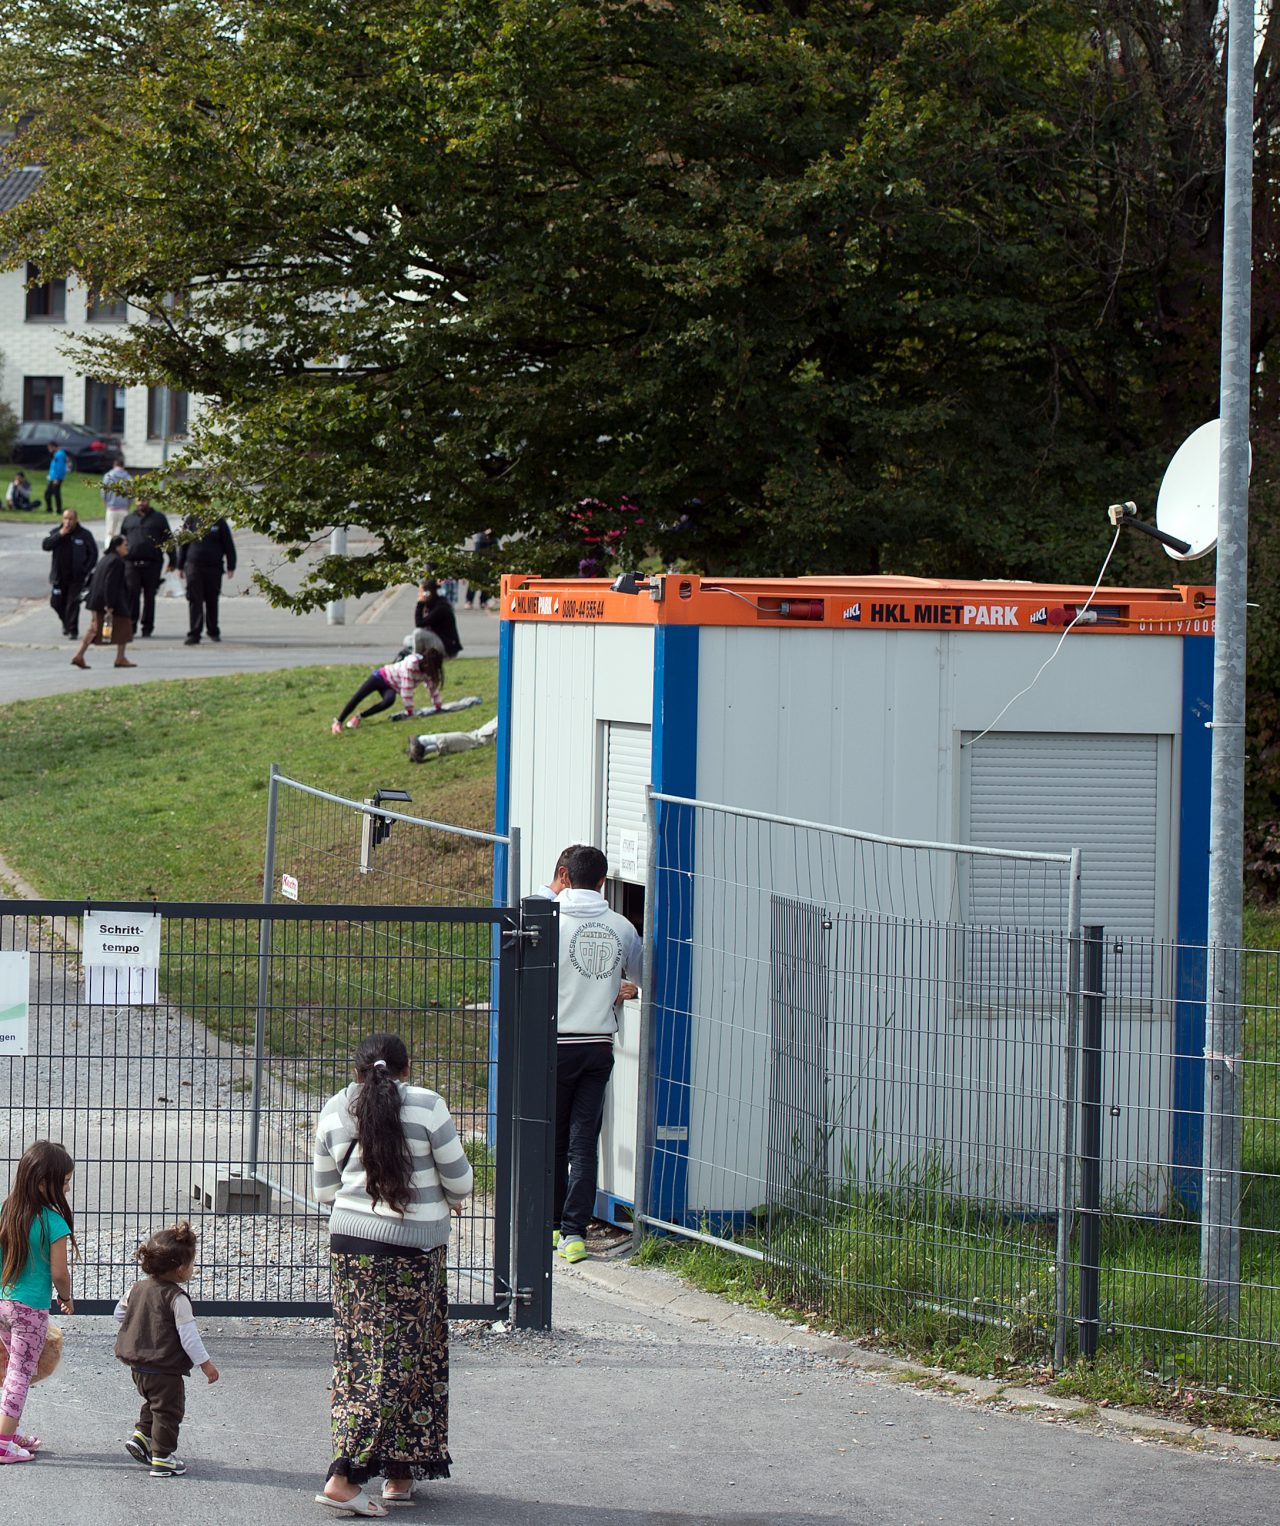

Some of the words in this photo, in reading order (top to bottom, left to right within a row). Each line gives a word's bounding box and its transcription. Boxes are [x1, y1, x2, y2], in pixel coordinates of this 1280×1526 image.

[843, 603, 861, 619] HKL
[871, 604, 910, 623] HKL
[914, 604, 1019, 625] MIETPARK
[1030, 608, 1047, 623] HKL
[100, 925, 144, 934] Schritt-
[102, 943, 140, 953] tempo
